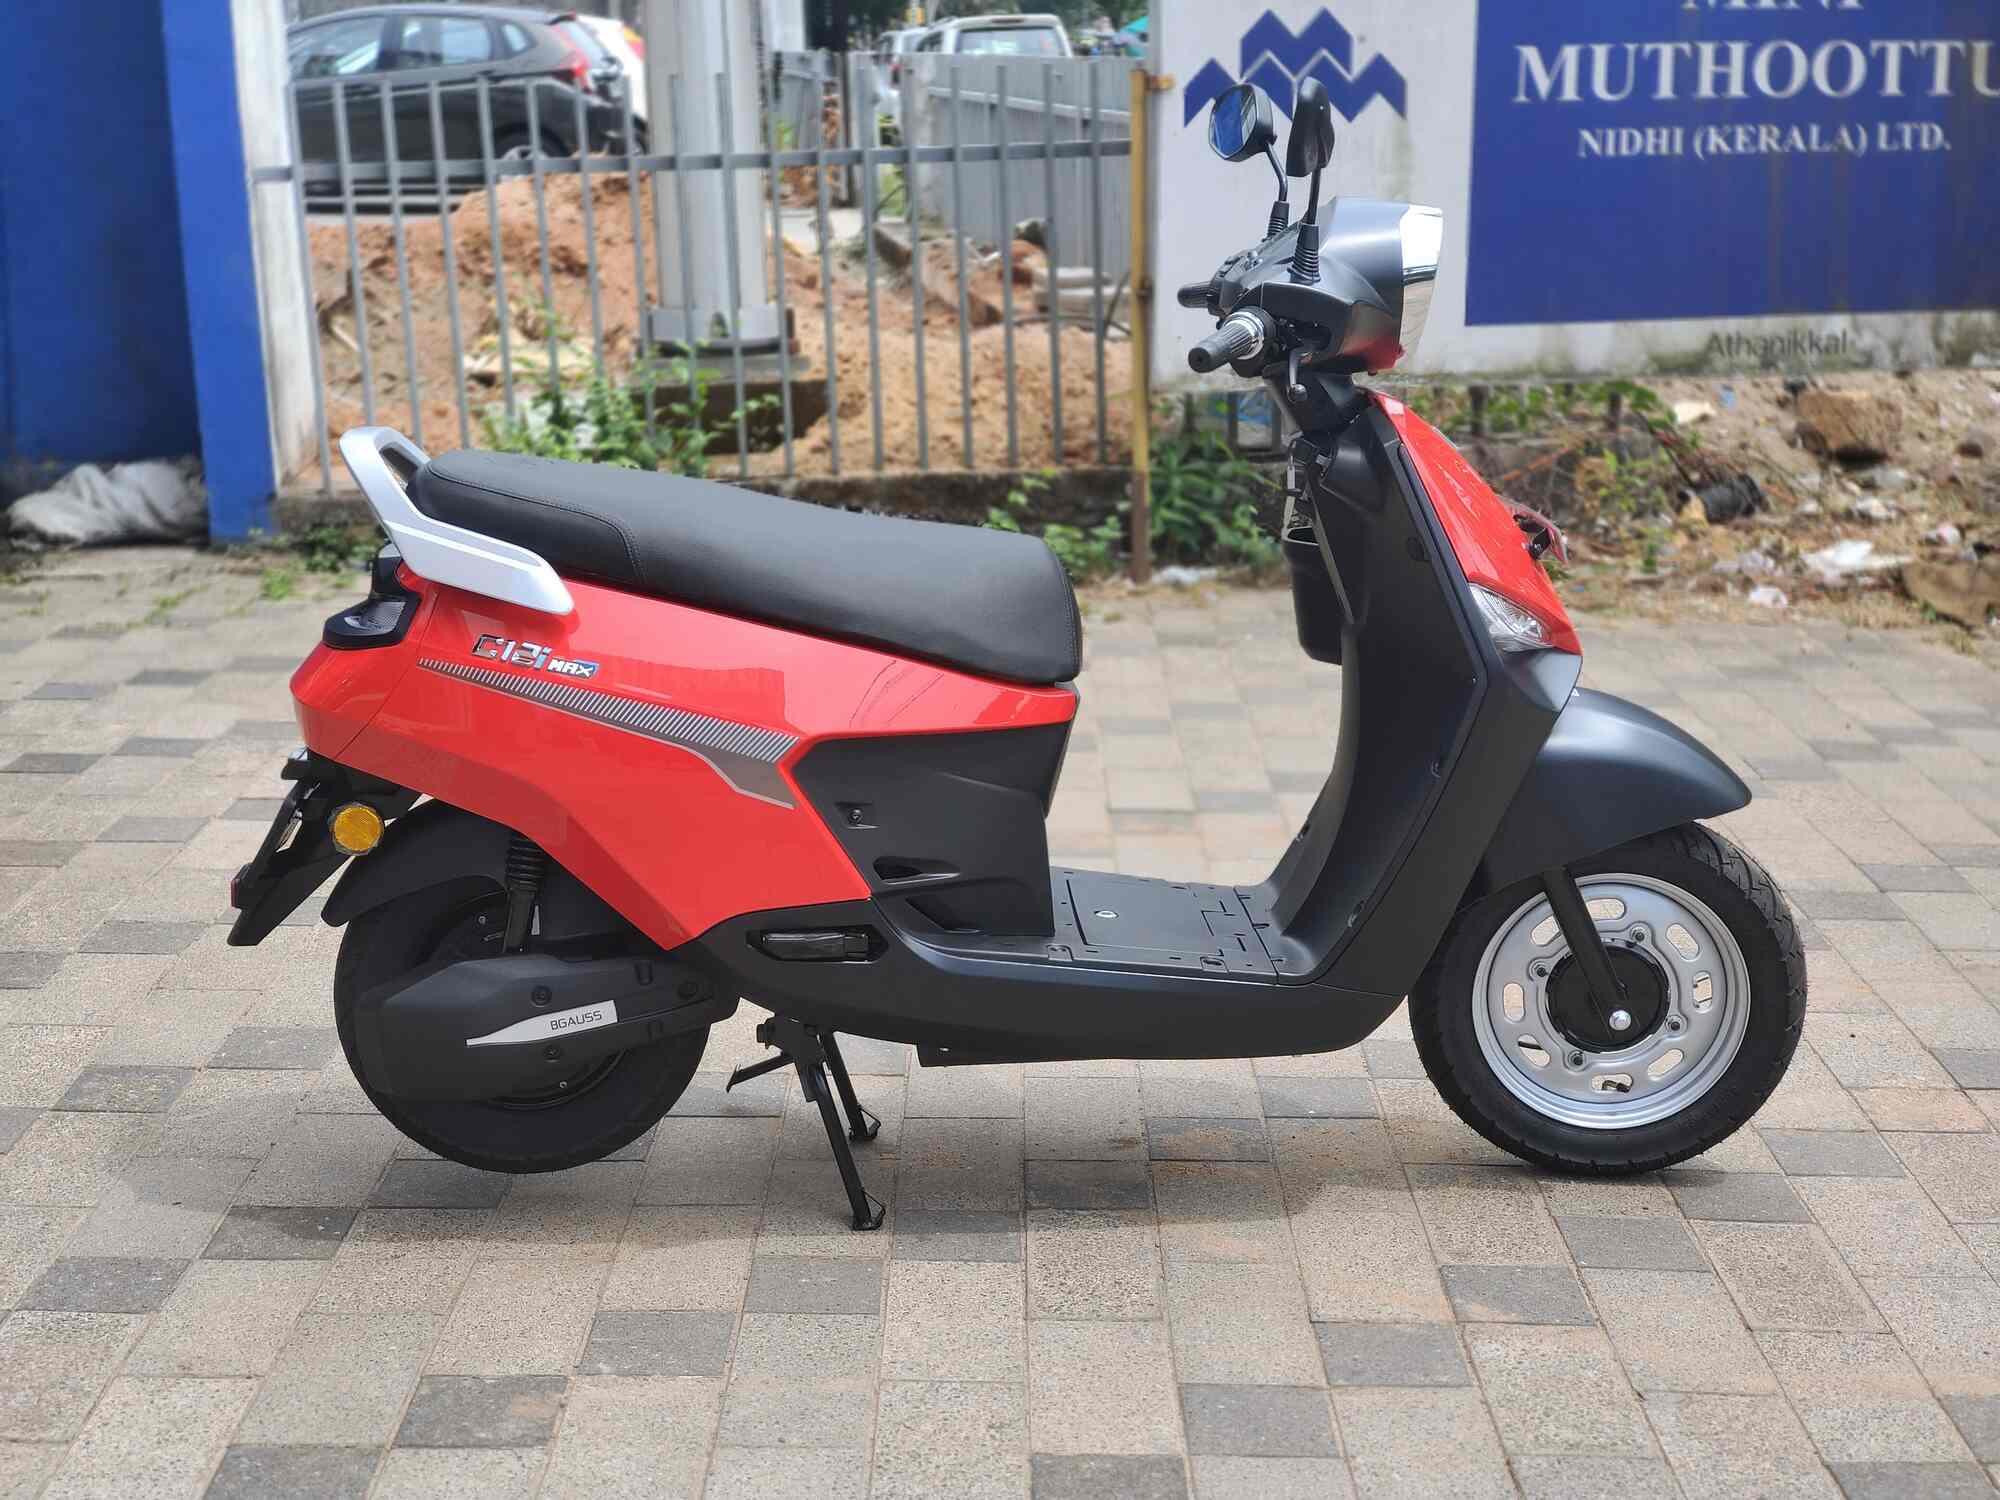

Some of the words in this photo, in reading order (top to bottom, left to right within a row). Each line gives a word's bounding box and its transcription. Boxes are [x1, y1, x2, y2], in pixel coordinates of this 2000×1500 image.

[1577, 127, 1684, 157] NIDHI
[1692, 124, 1868, 160] (KERALA)
[1876, 122, 1952, 152] LTD.
[550, 1010, 602, 1030] BGAUSS
